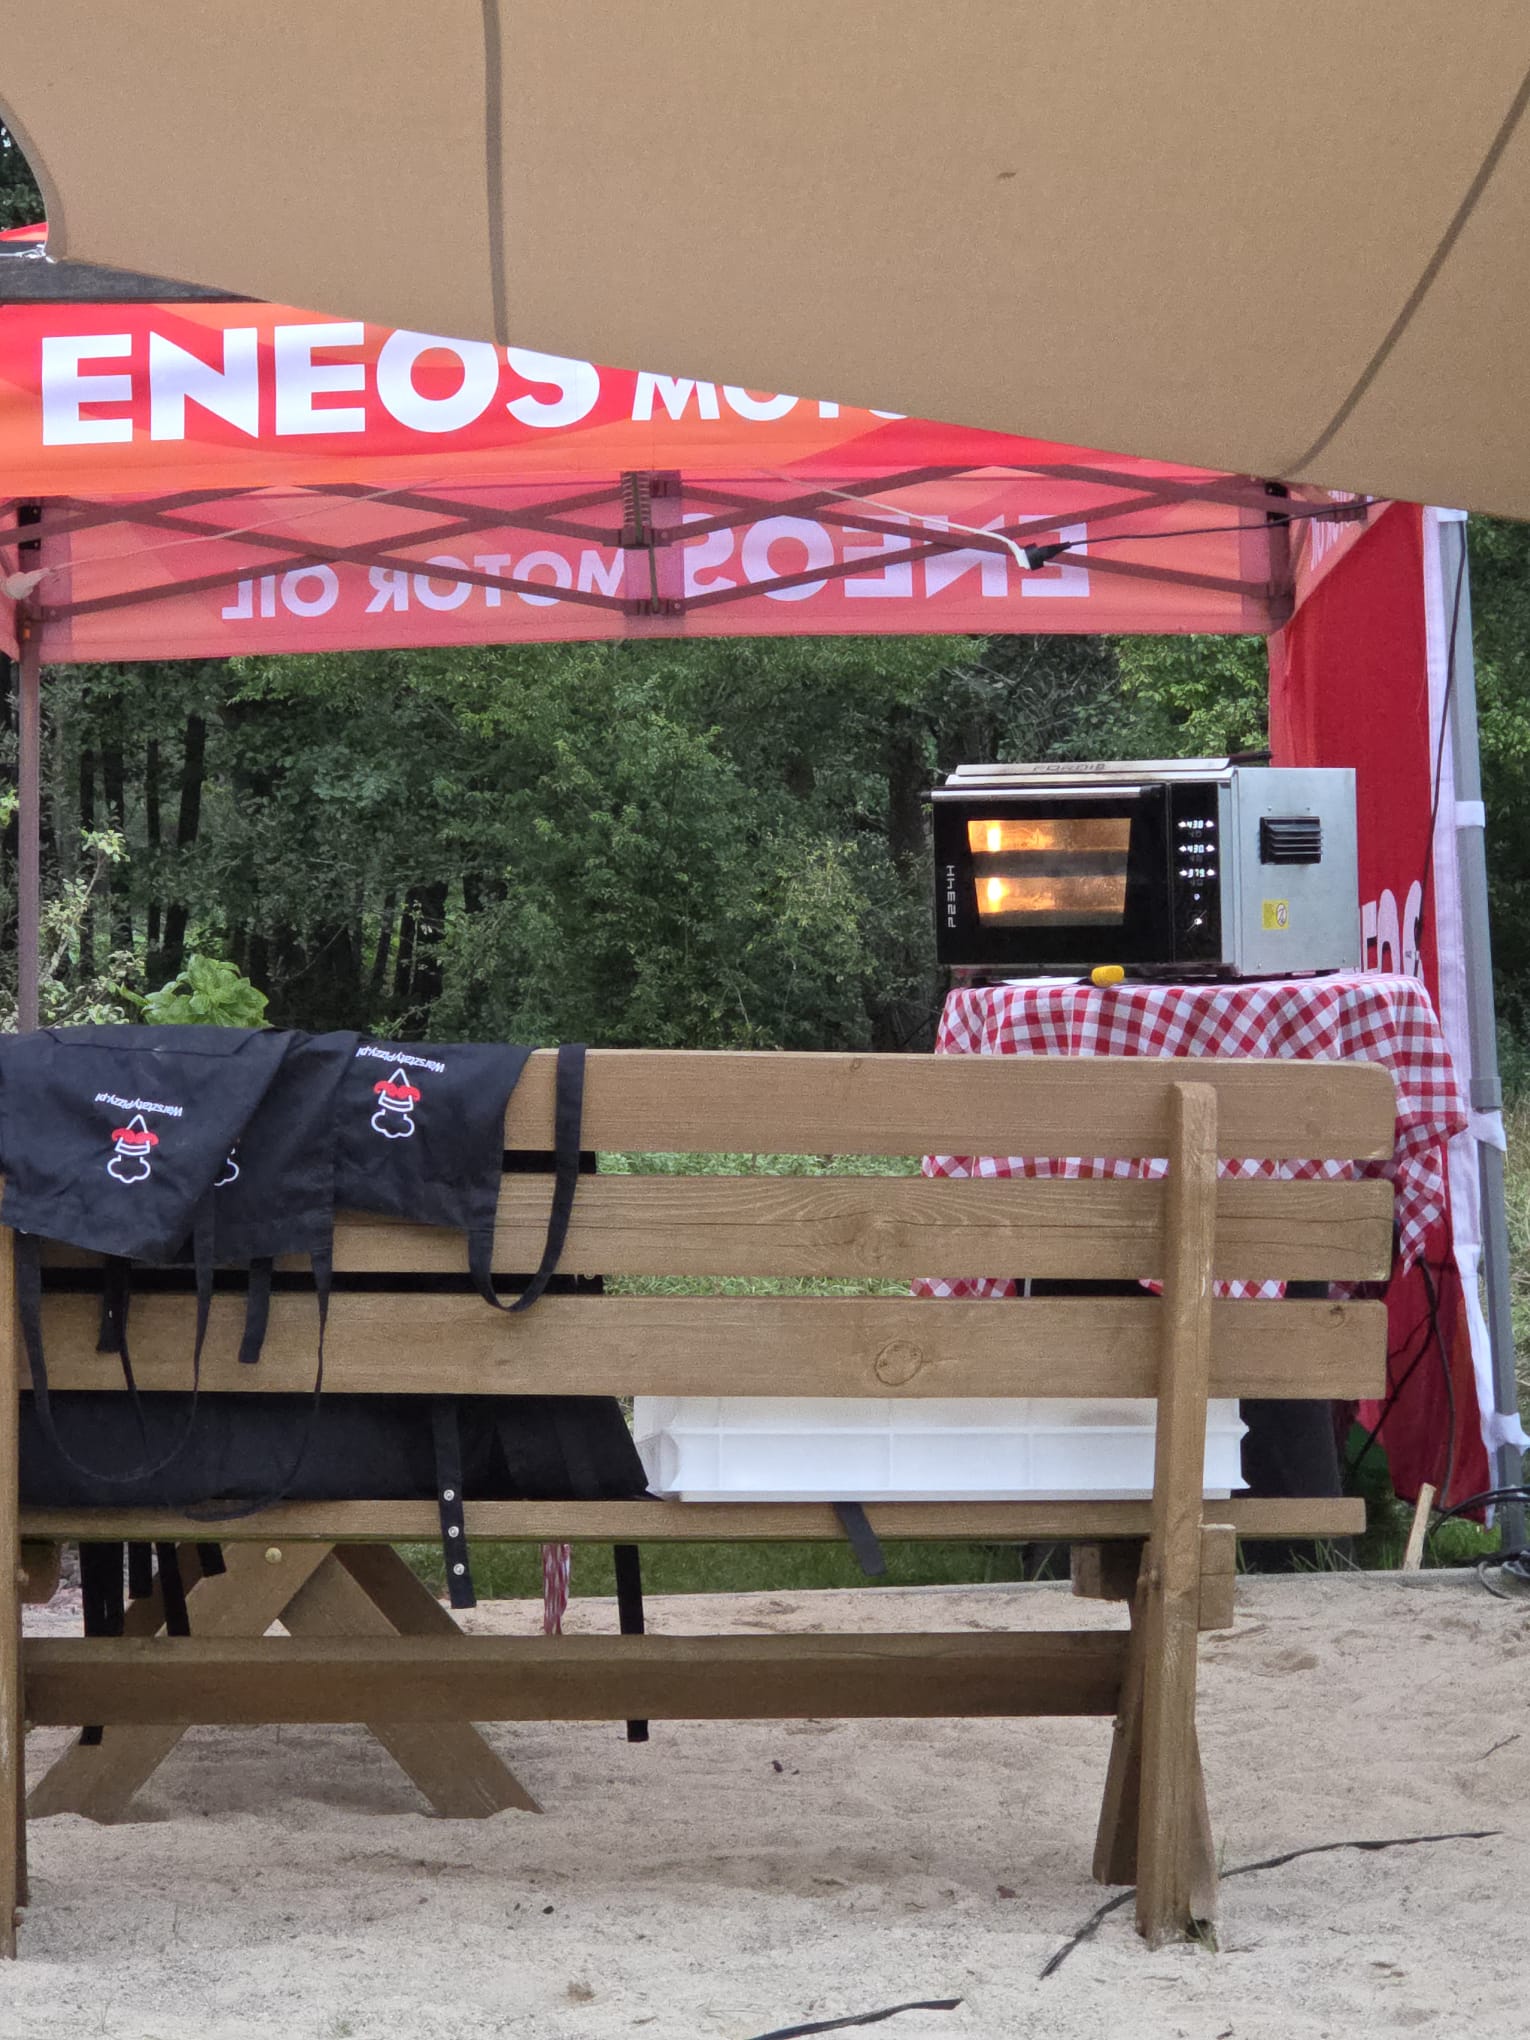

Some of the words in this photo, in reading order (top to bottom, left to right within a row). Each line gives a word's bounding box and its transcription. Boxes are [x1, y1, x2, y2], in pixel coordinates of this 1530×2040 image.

[42, 322, 600, 446] ENEOS
[946, 864, 957, 929] P234H
[355, 1046, 446, 1074] WarsztatyPizzy.pl
[94, 1092, 184, 1118] WarsztatyPizzy.pl
